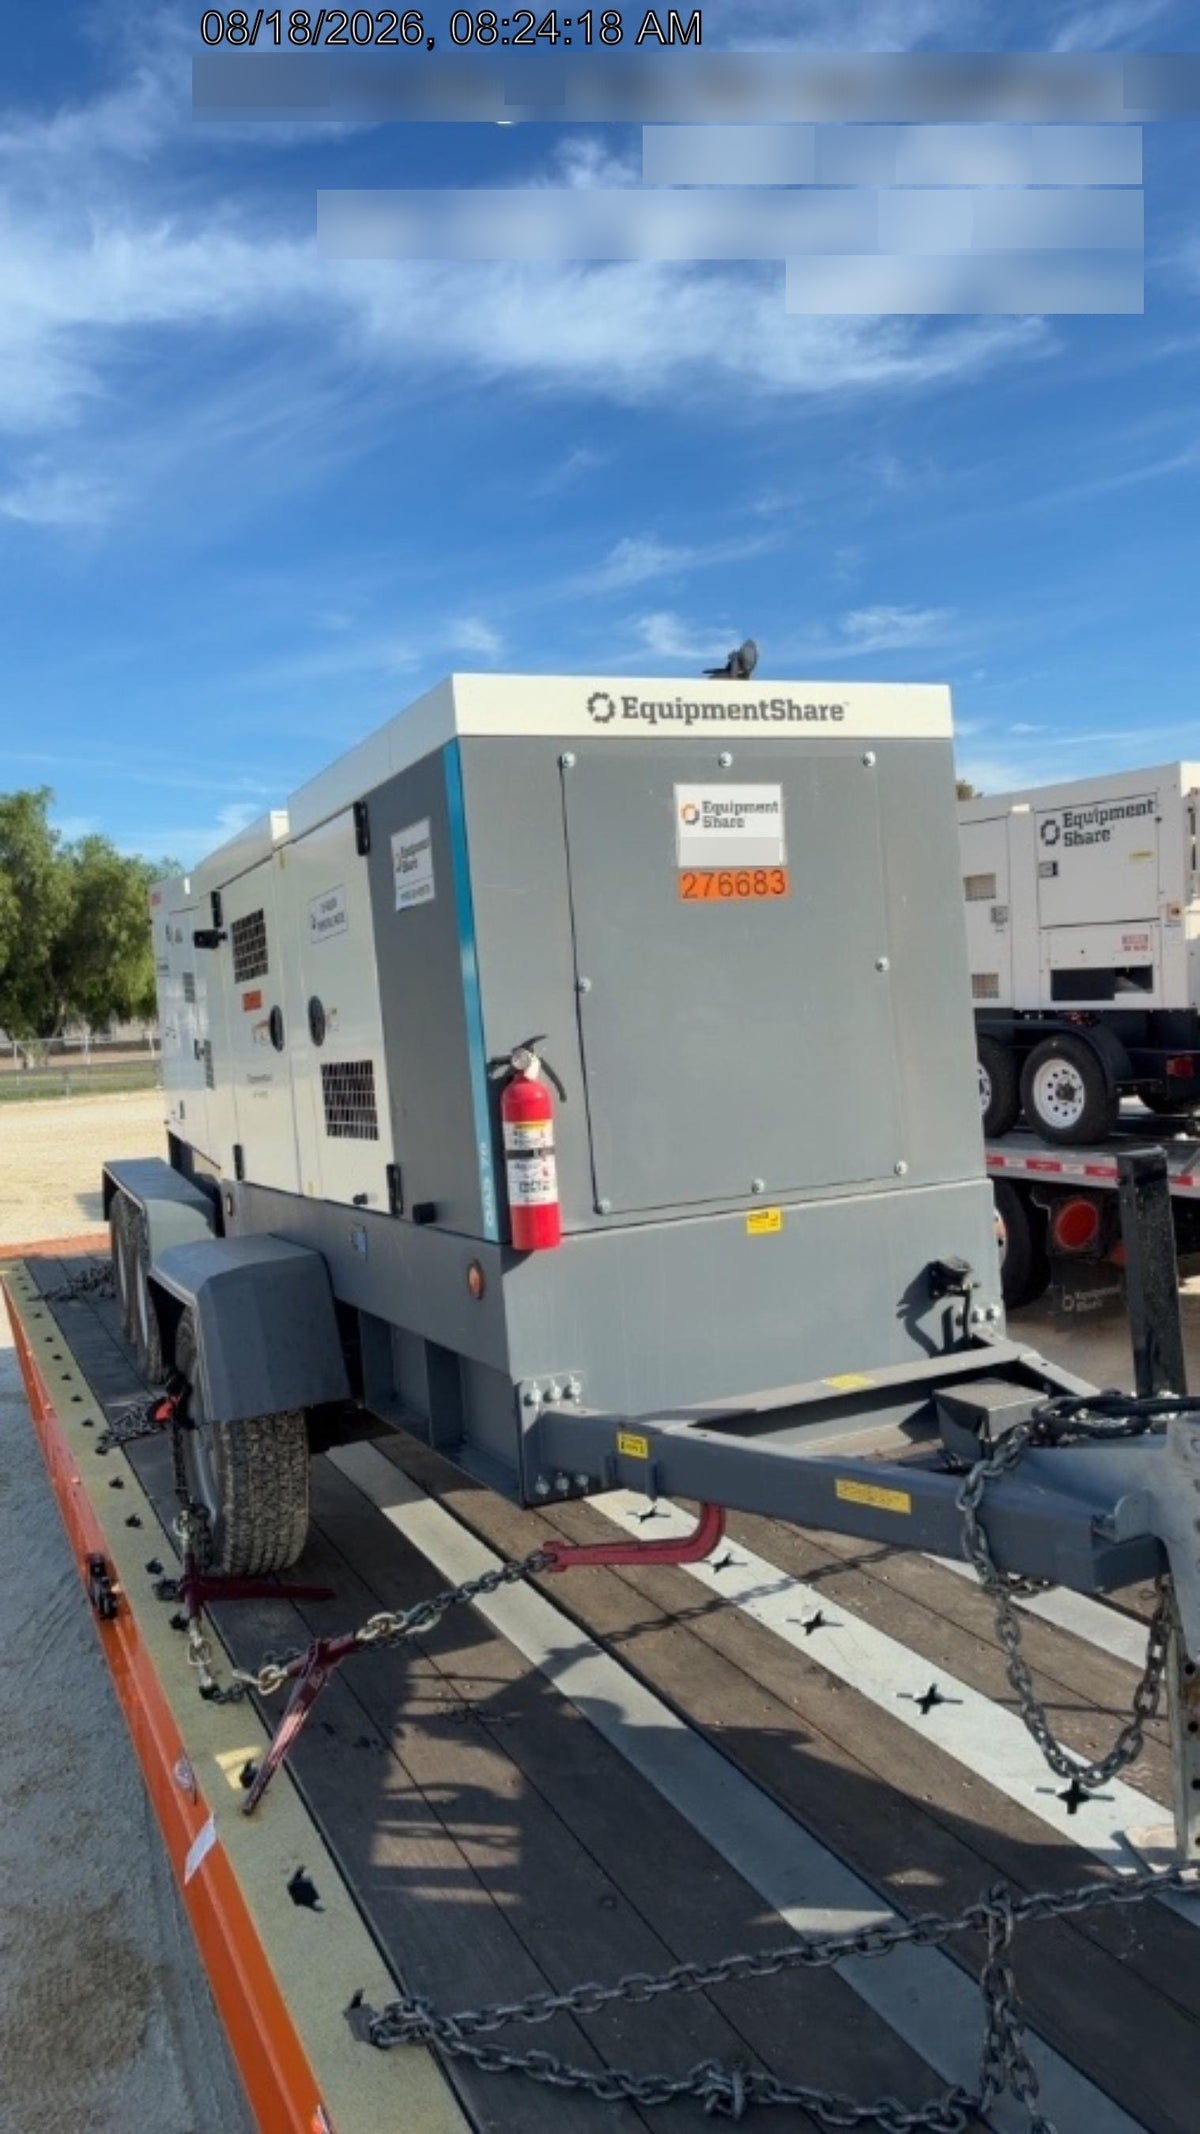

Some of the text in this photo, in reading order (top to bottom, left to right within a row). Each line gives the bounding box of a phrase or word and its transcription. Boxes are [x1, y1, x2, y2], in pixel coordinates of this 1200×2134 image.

[620, 696, 845, 725] EquipmentShare
[702, 800, 779, 816] Equipment
[1062, 799, 1154, 829] Equipment
[702, 816, 745, 828] Share
[1063, 829, 1111, 847] Share
[682, 870, 786, 899] 276683
